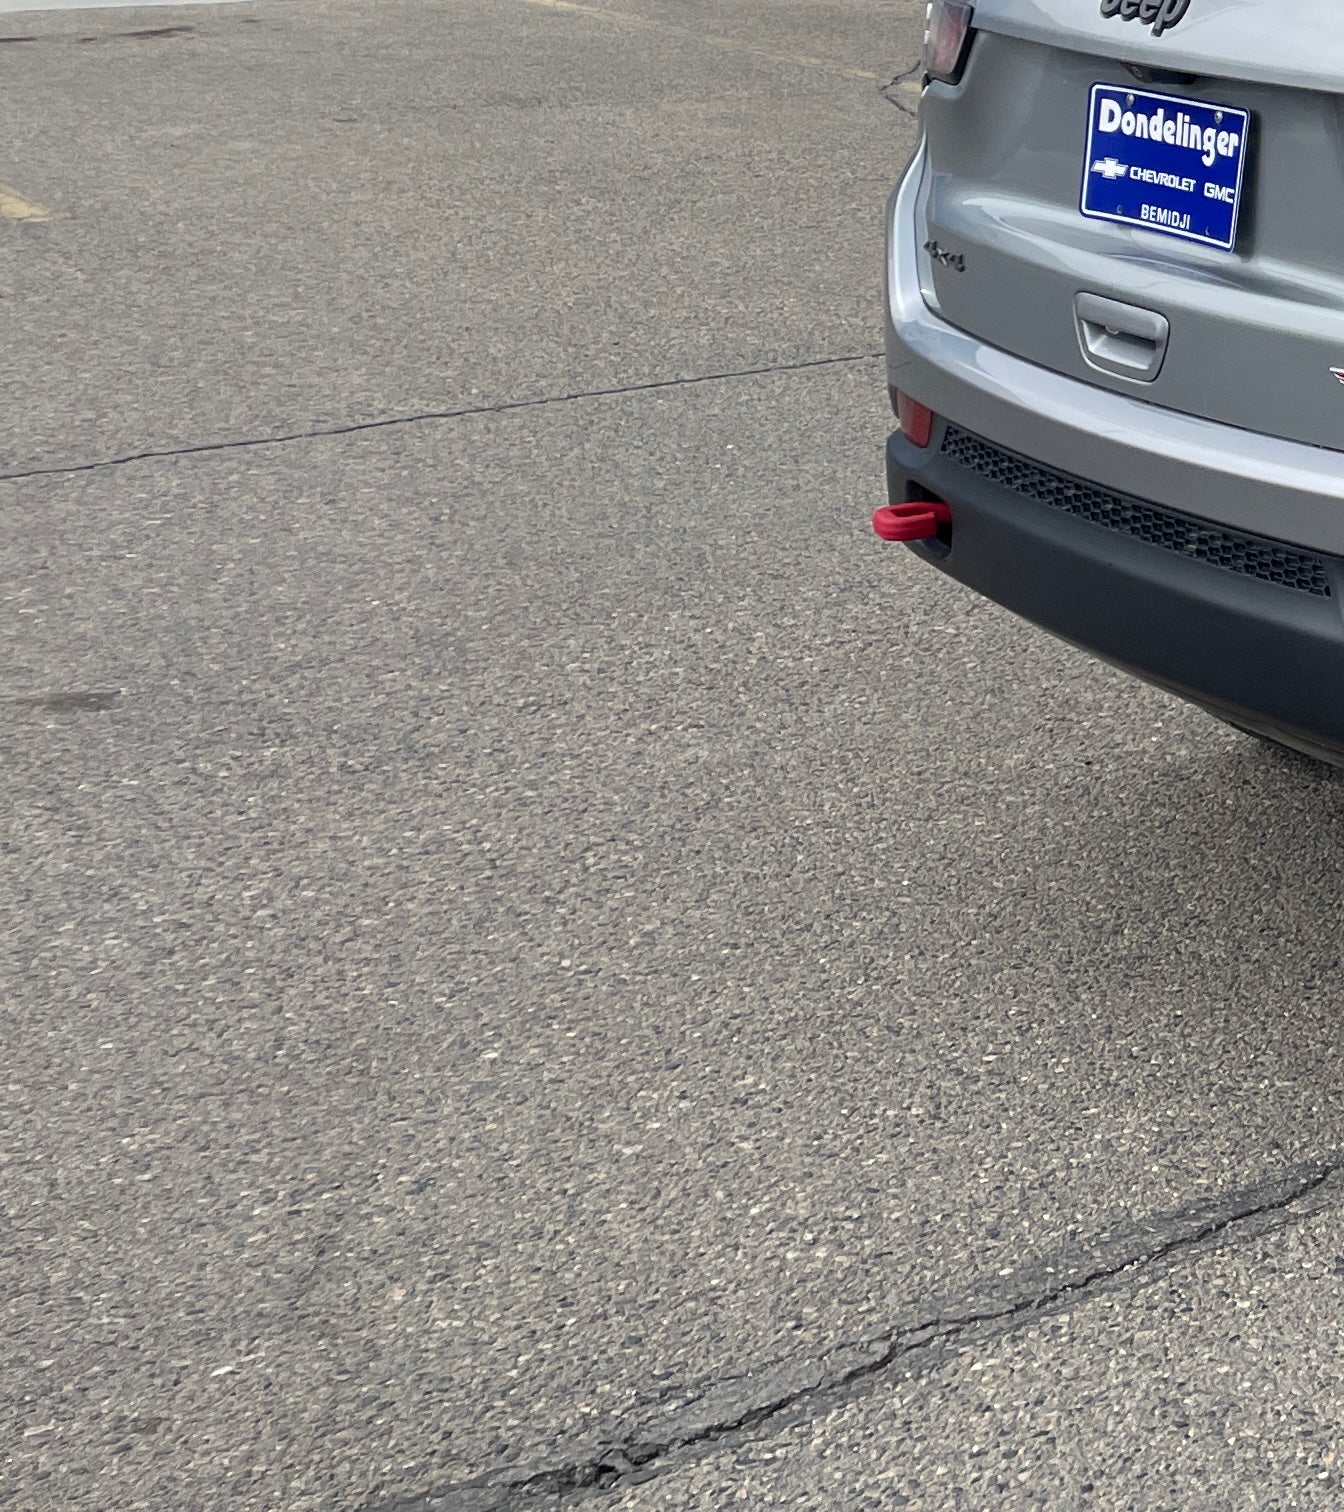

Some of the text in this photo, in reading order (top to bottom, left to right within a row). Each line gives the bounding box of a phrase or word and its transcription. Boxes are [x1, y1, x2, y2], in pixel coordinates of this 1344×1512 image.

[1098, 97, 1239, 167] Dondelinger
[1129, 166, 1235, 204] CHEVROLET GMC
[1140, 203, 1191, 230] BEMIDJI
